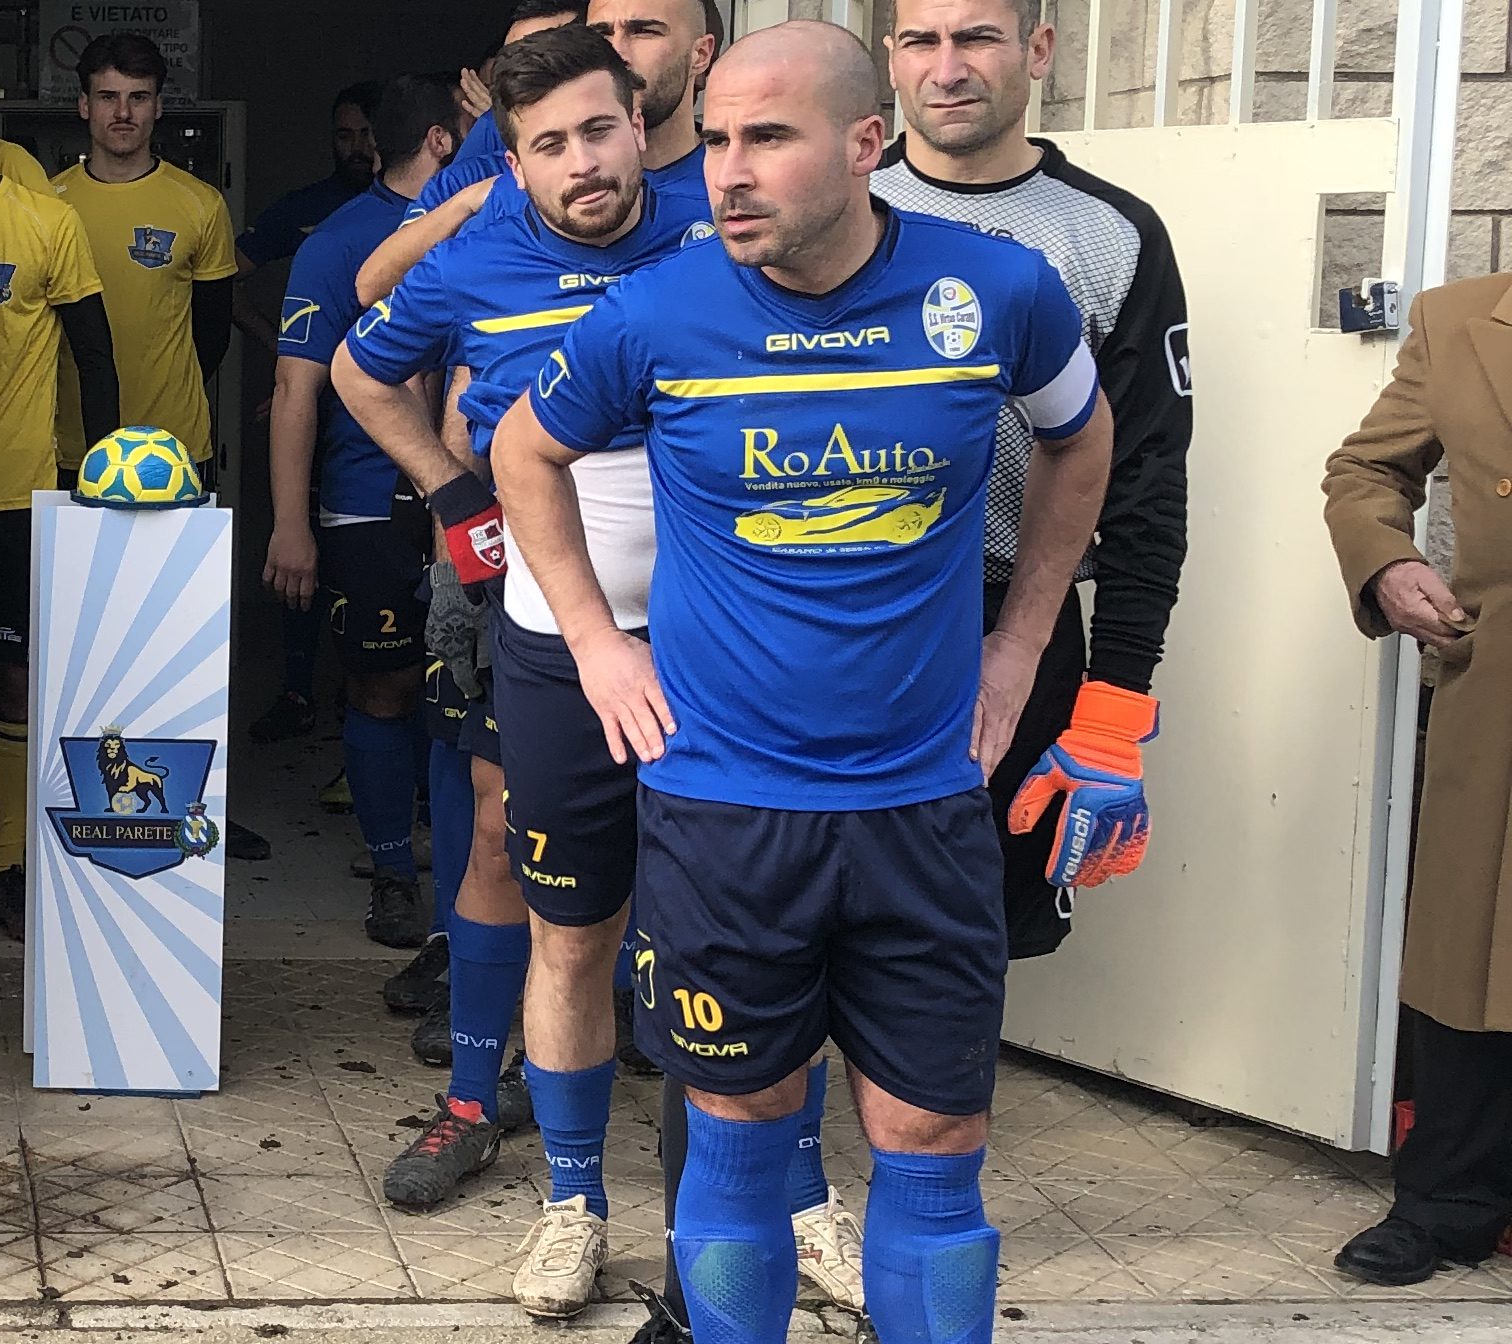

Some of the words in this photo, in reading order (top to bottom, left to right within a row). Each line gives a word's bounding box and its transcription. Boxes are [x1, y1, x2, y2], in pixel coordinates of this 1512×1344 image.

[89, 6, 168, 22] VIETATO
[766, 326, 890, 352] GIVOVA
[745, 482, 785, 491] Vendita
[890, 475, 936, 484] noleggio
[379, 609, 397, 633] 2
[72, 825, 111, 839] REAL
[116, 826, 172, 840] PARETE
[1061, 808, 1091, 882] reusch
[527, 829, 547, 862] 7
[673, 989, 723, 1032] 10
